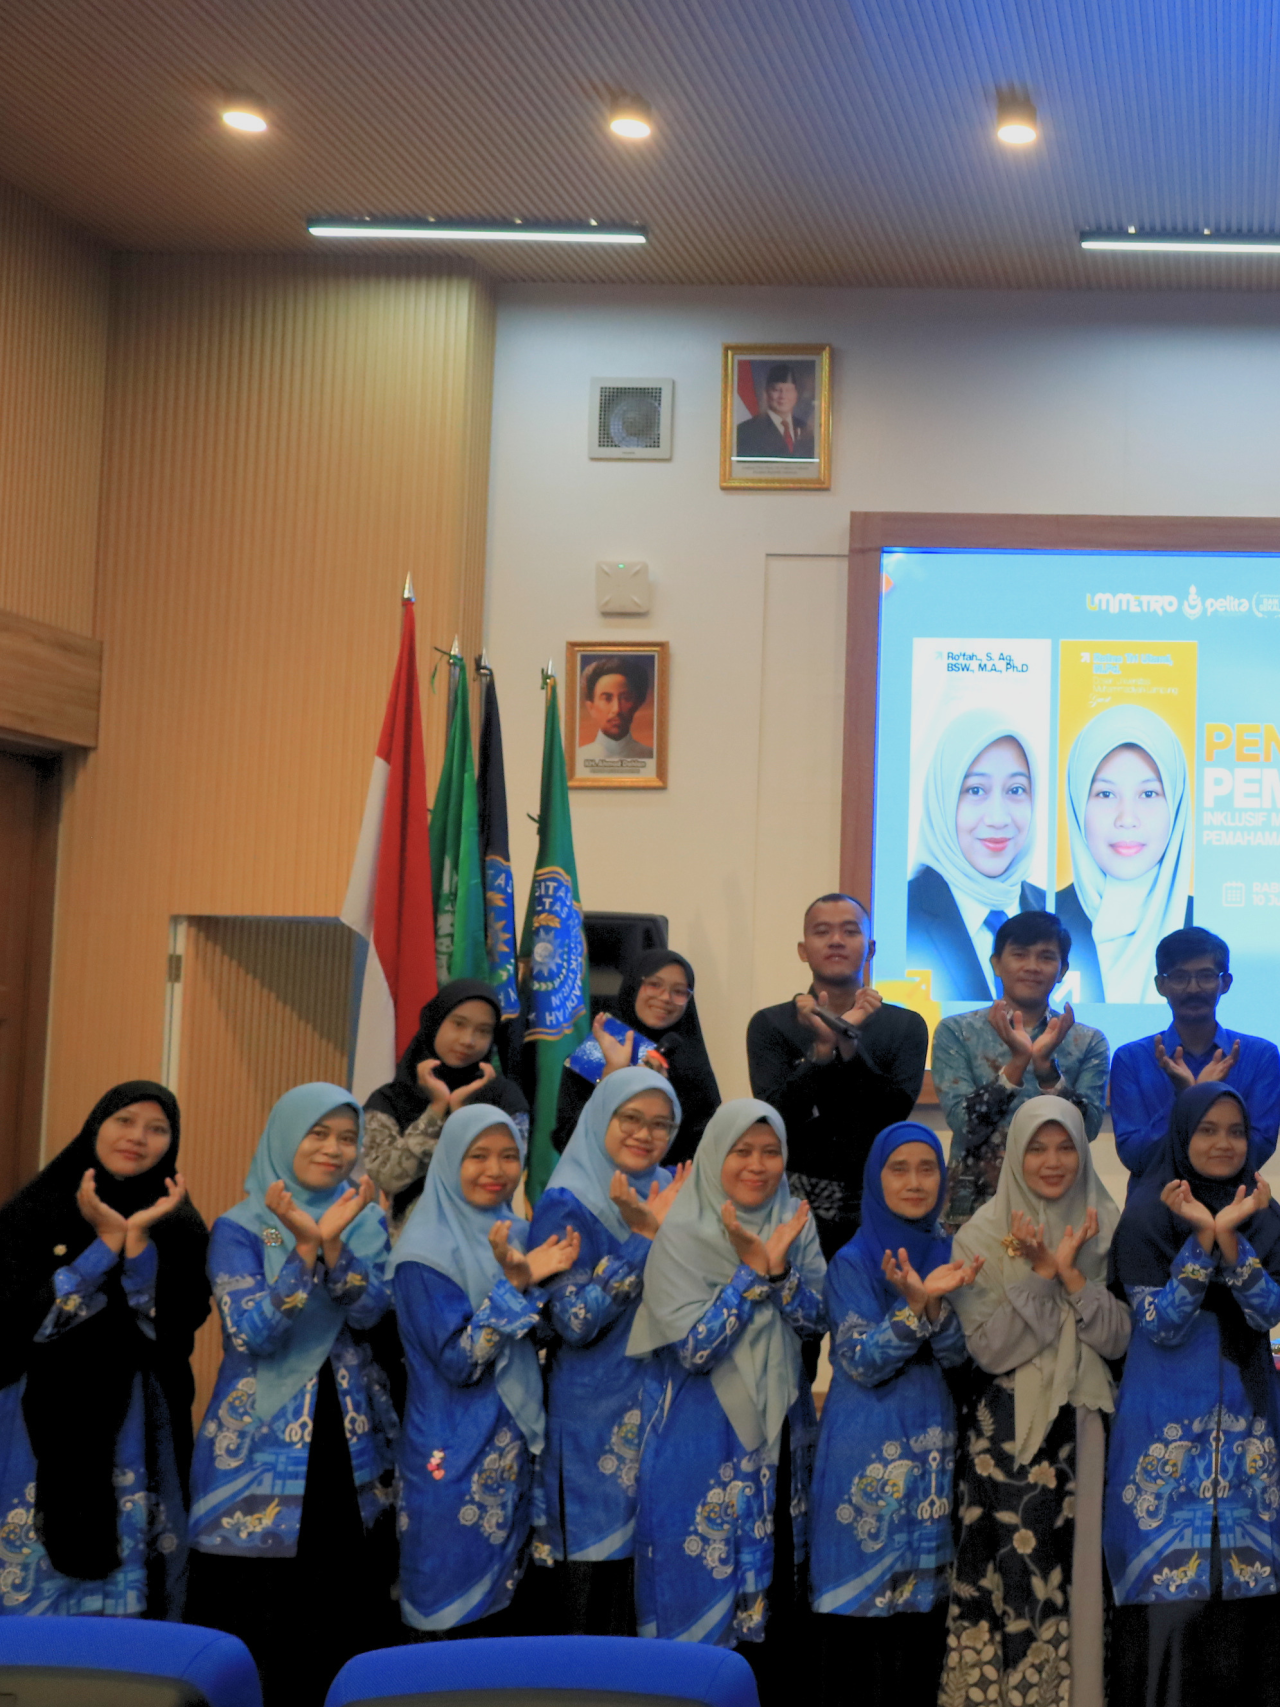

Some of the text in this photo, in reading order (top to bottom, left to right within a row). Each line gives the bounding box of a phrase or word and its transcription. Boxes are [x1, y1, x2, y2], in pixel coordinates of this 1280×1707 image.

[1205, 595, 1249, 617] pelita
[1005, 662, 1029, 673] Ph.D
[1203, 811, 1267, 827] INKLUSIF
[1252, 895, 1265, 906] 10
